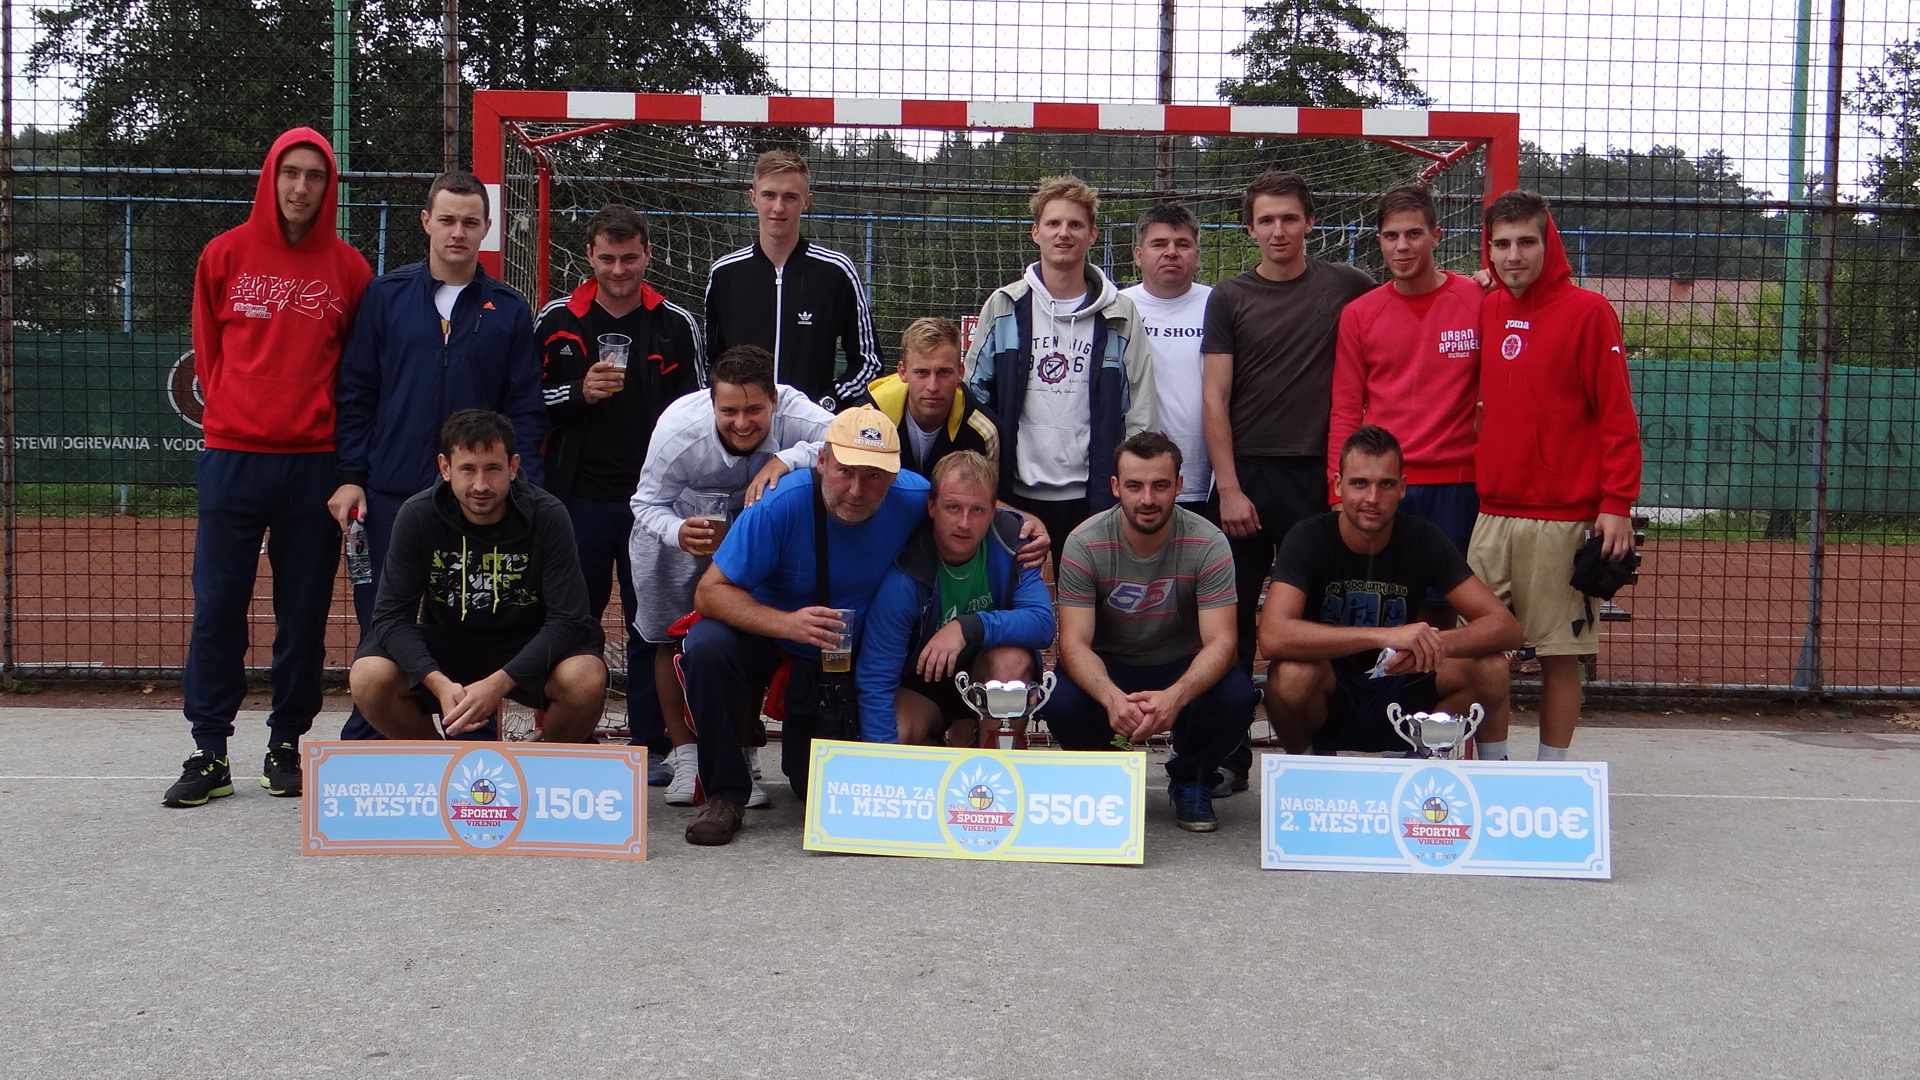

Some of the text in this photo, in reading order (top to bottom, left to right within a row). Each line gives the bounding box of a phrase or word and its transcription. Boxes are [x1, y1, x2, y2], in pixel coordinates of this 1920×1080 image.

[1441, 328, 1474, 342] URBAN
[1438, 339, 1480, 353] APPAREL
[324, 783, 438, 797] NAGRADA ZA
[827, 781, 935, 800] NAGRADA ZA
[324, 798, 438, 817] 3. MESTO
[535, 787, 622, 821] 150€
[828, 796, 933, 820] 1. MESTO
[1028, 794, 1124, 826] 550€
[1280, 797, 1389, 813] NAGRADA ZA
[1280, 812, 1390, 834] 2. MESTO
[1485, 806, 1588, 839] 300€
[1418, 838, 1453, 846] VIKENDI
